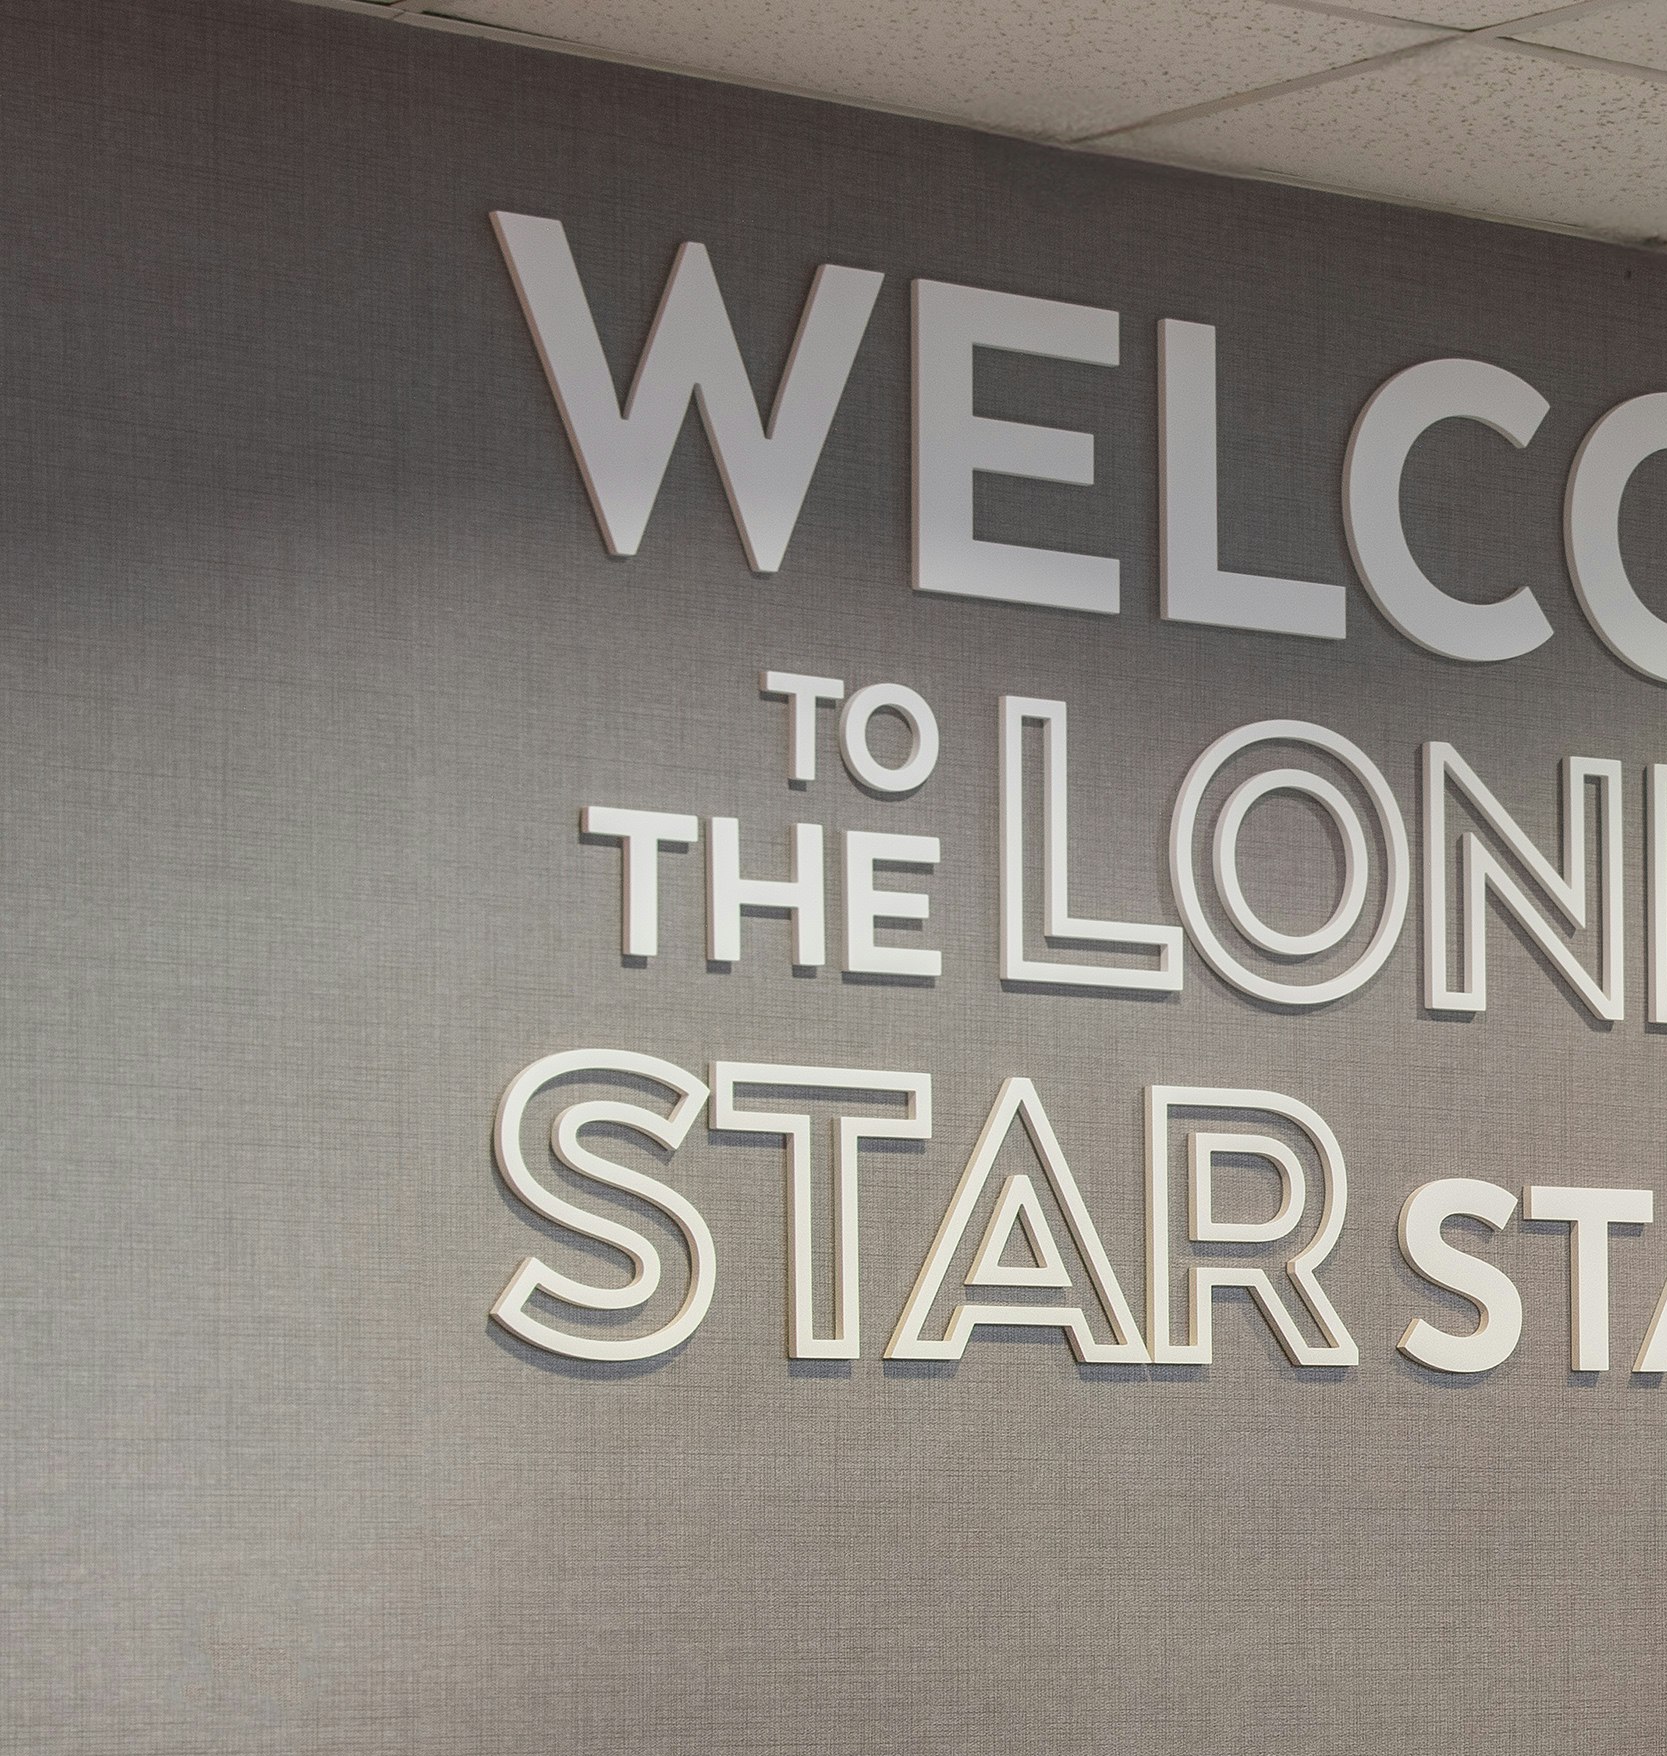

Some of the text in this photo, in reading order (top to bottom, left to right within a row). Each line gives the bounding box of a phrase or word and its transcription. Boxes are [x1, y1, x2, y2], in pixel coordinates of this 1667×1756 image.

[762, 670, 942, 795] TO
[581, 805, 943, 980] THE
[490, 1047, 1360, 1368] STAR
